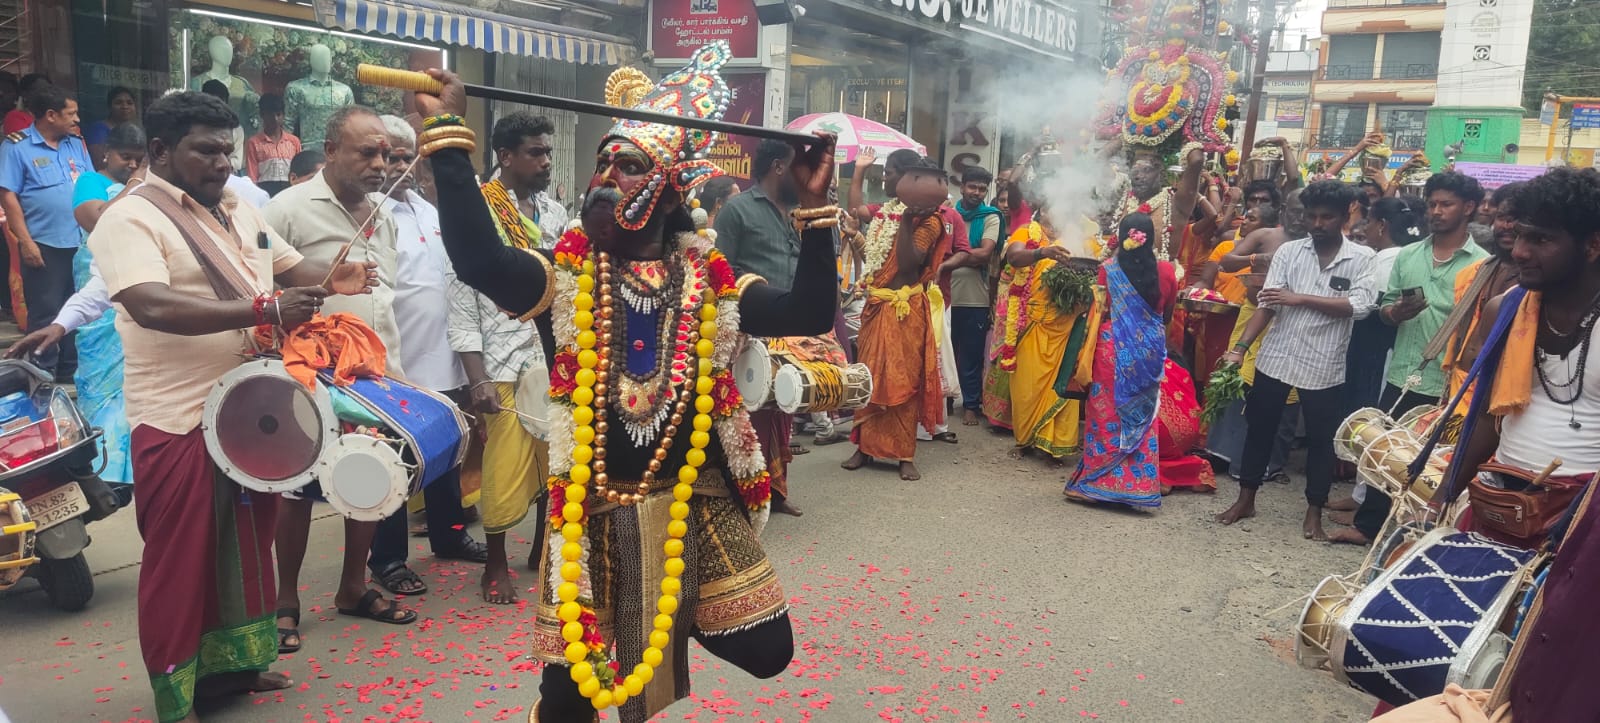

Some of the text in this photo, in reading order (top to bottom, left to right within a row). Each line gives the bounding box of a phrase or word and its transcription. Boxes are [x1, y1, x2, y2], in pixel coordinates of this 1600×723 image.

[686, 18, 698, 26] கார்
[701, 16, 728, 26] பார்க்கிங்
[731, 15, 749, 26] வசதி
[961, 0, 1077, 52] JEWELLERS
[675, 27, 710, 37] ஹோட்டல்
[676, 37, 702, 47] அருகில்
